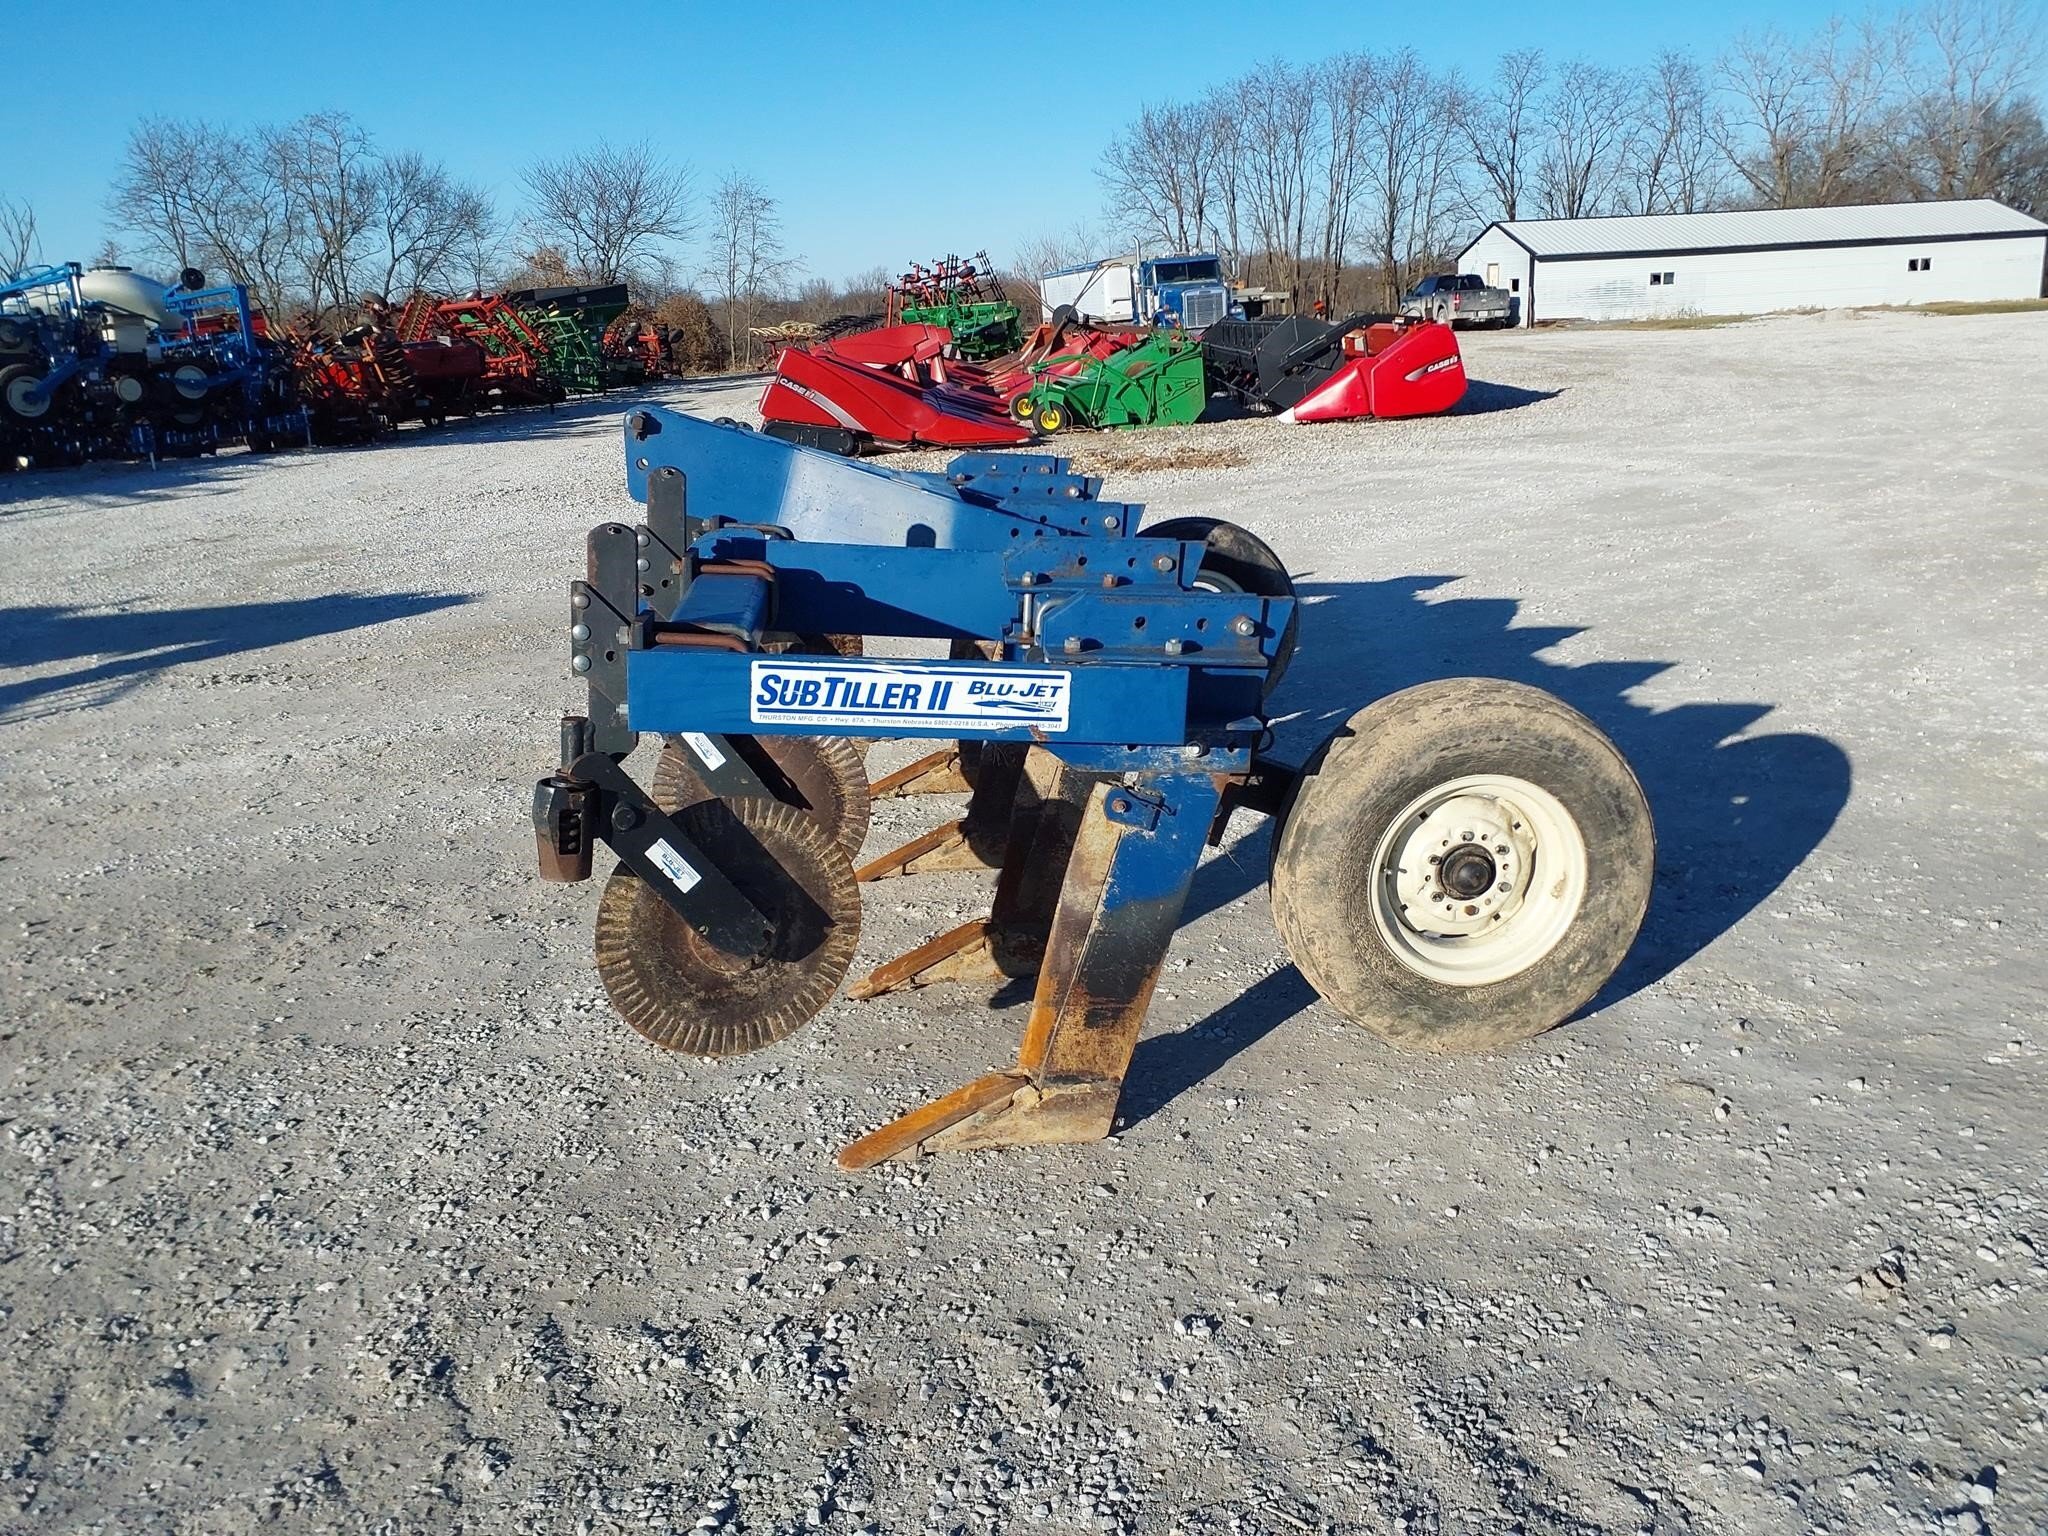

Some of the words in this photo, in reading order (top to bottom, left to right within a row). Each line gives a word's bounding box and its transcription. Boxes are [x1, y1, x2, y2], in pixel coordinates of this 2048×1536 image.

[1427, 358, 1450, 373] CASE
[779, 378, 806, 395] CASE
[927, 681, 953, 711] II
[759, 714, 796, 722] THURSTON
[872, 717, 902, 725] Thurston
[902, 718, 933, 726] Nebraska
